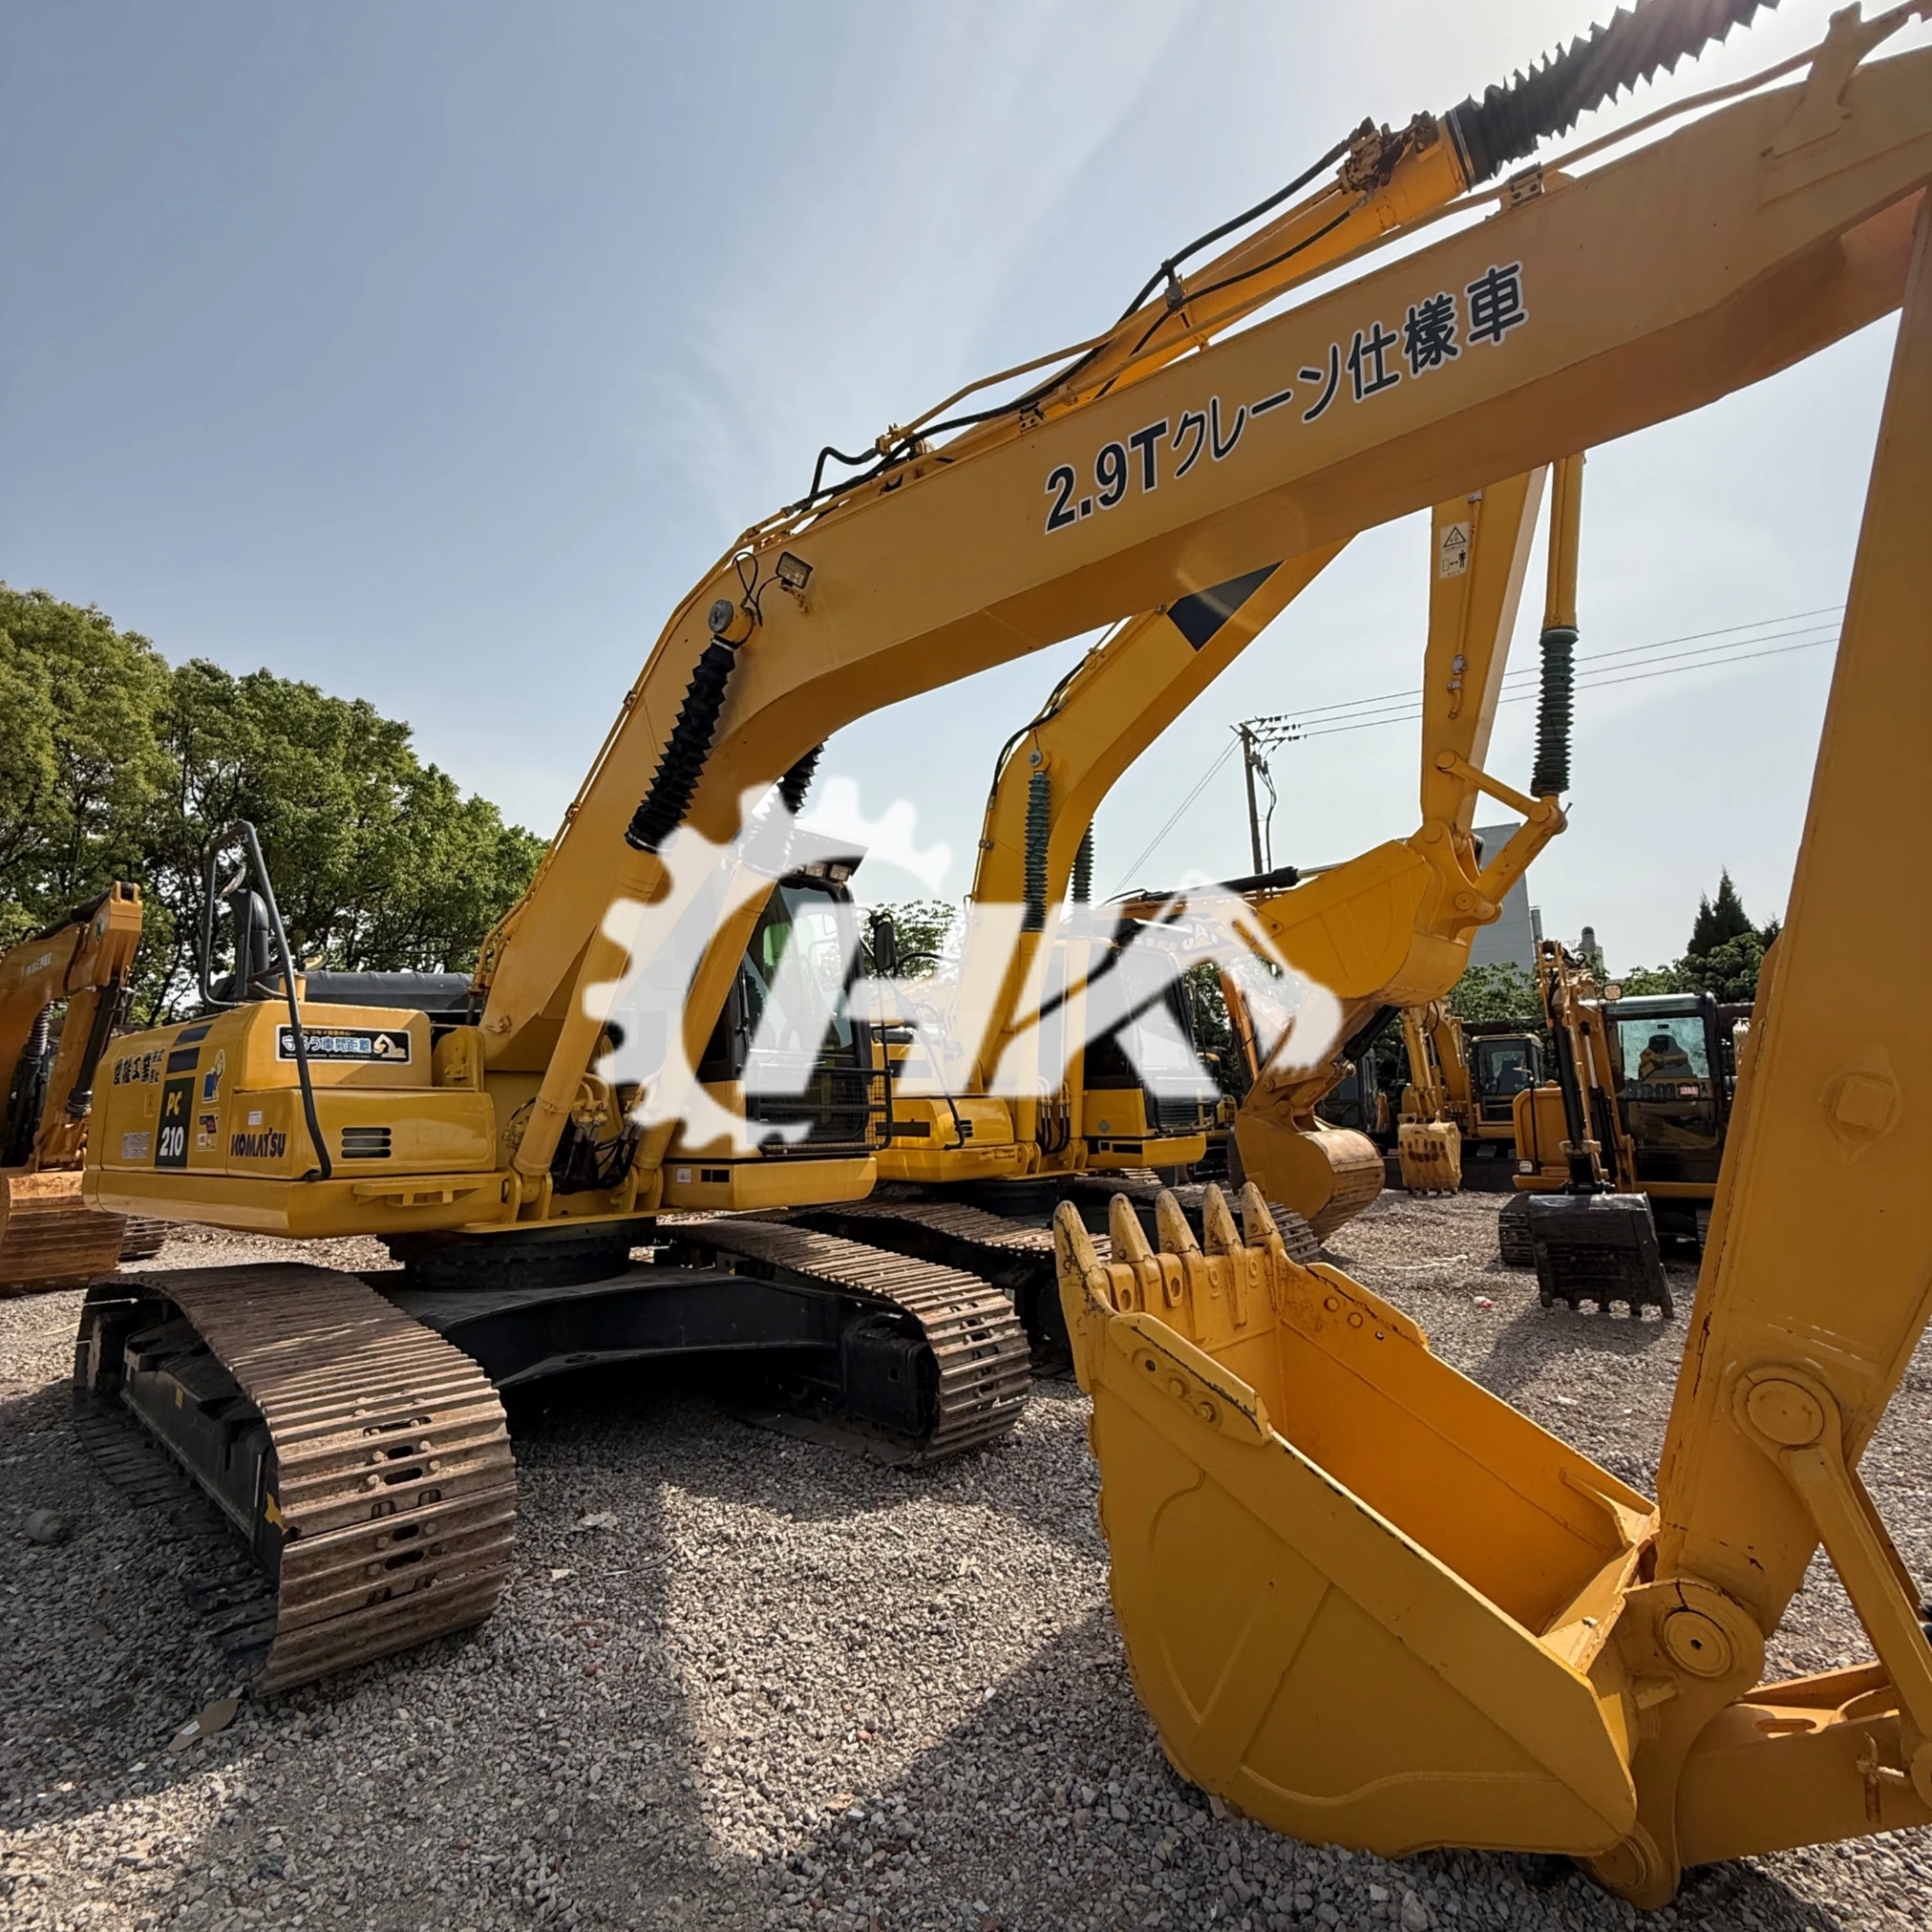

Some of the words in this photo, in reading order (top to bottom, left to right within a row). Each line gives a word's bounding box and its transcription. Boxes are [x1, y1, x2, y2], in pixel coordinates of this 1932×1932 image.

[165, 1091, 183, 1117] PC
[159, 1126, 185, 1157] 210
[229, 1127, 287, 1158] KOMATSU
